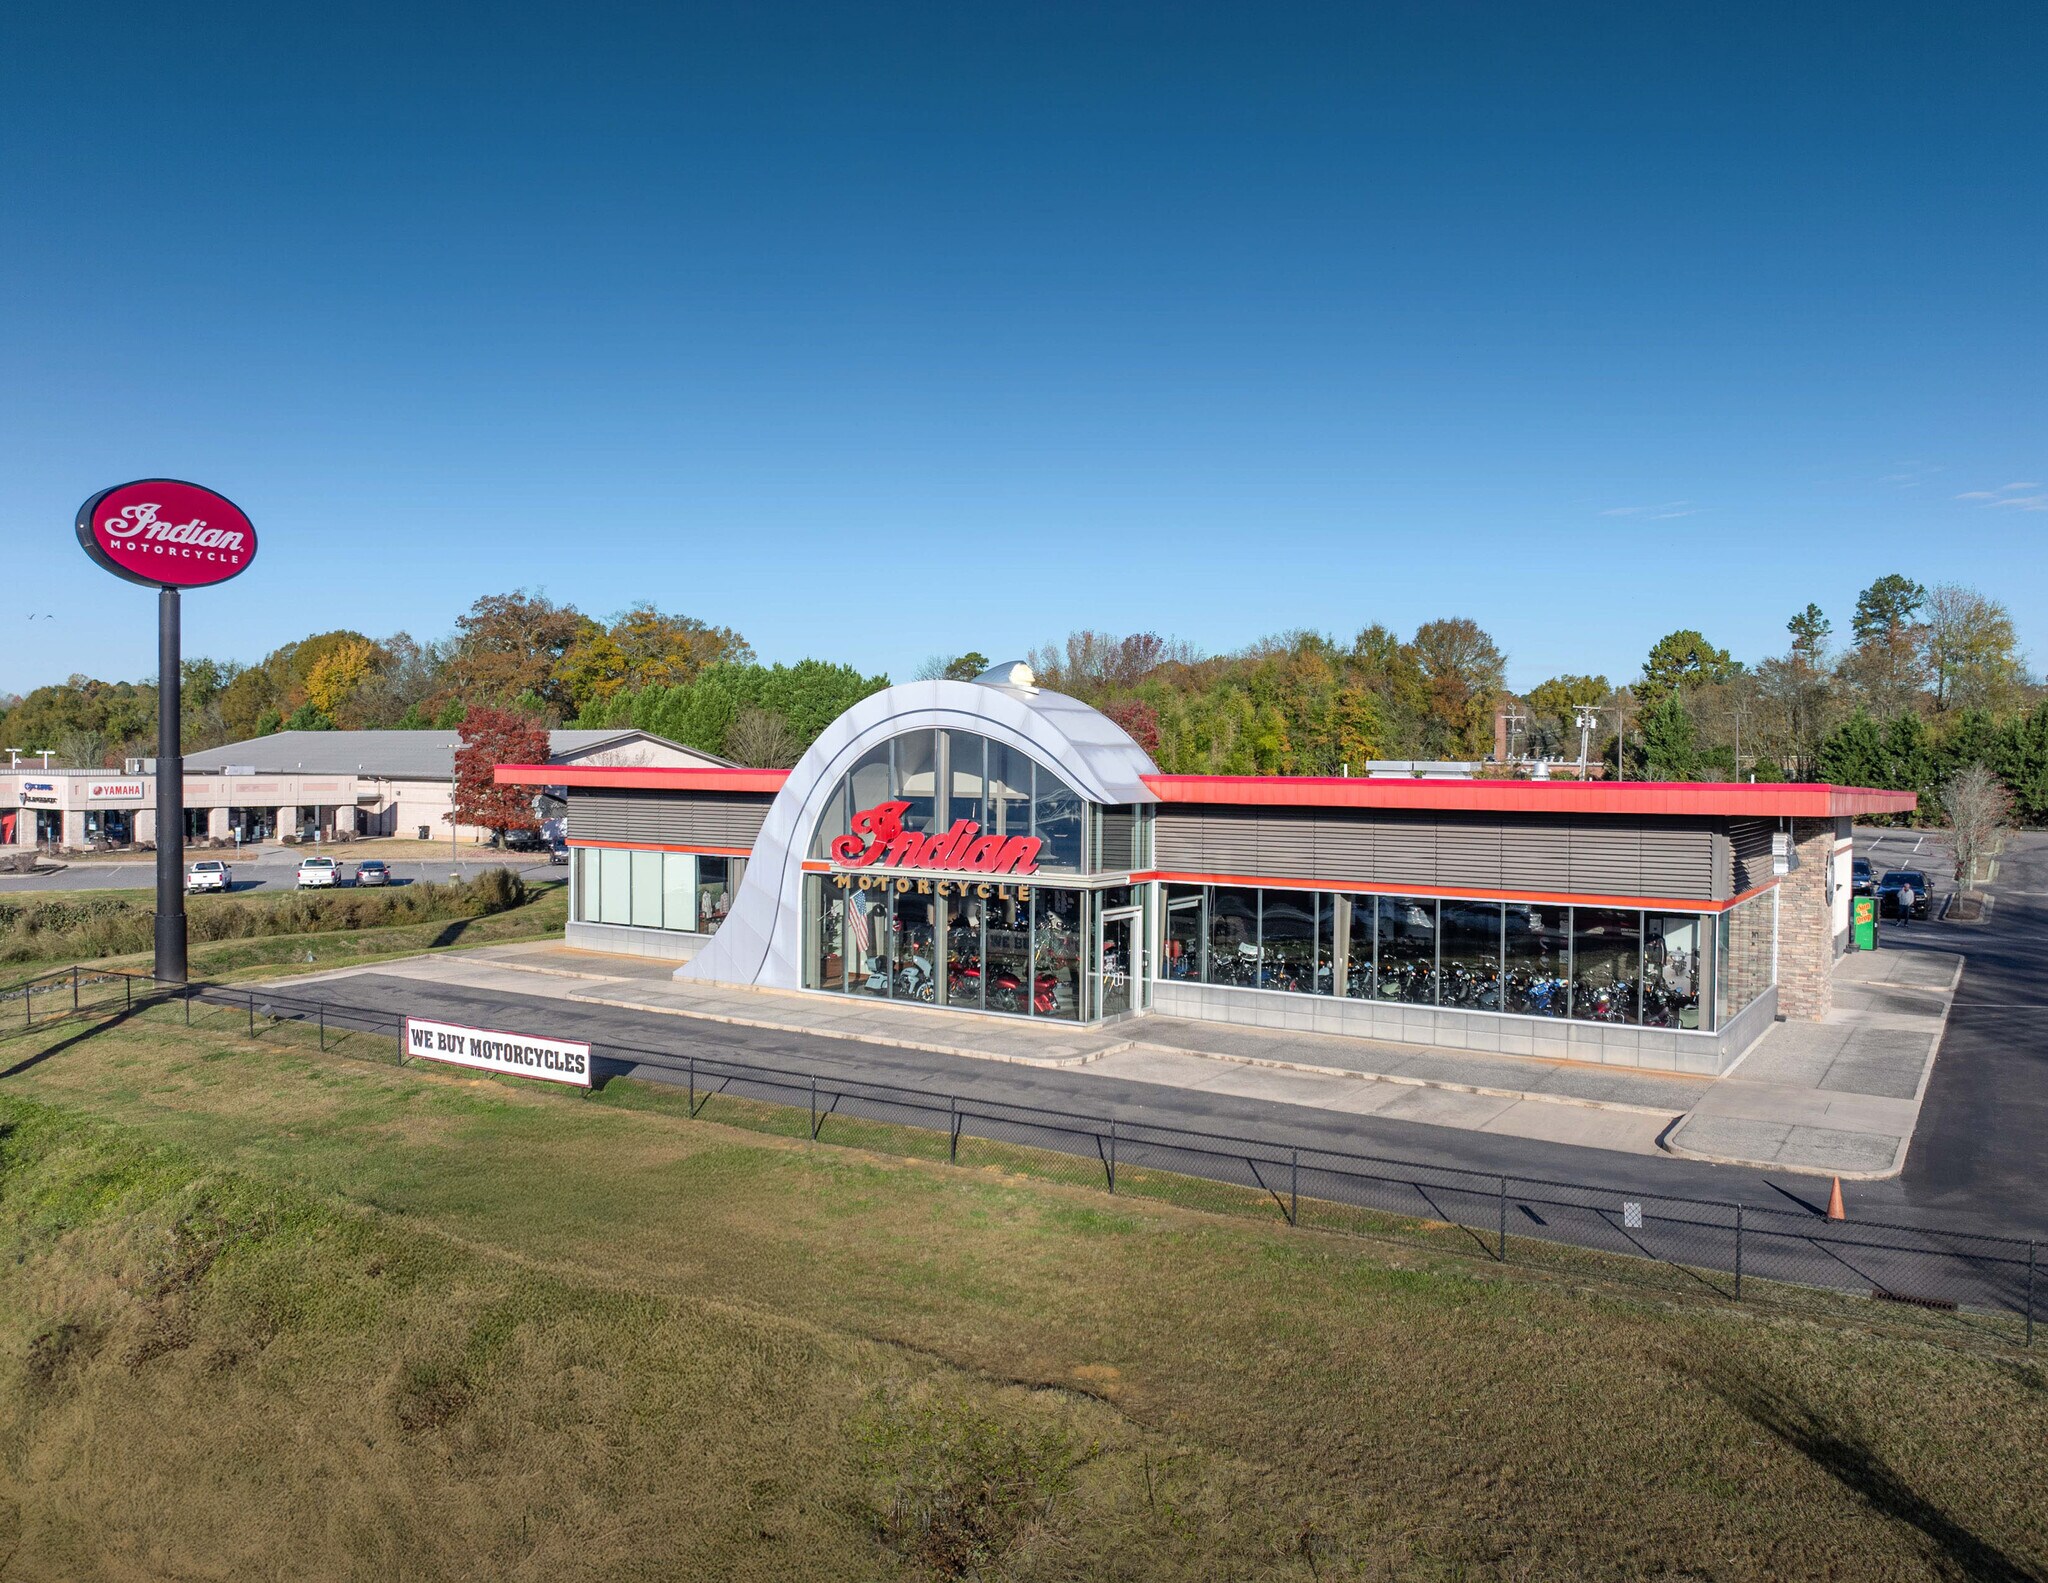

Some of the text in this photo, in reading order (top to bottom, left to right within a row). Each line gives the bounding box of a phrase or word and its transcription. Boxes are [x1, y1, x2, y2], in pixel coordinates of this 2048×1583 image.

[104, 503, 244, 551] Indian
[110, 539, 239, 564] MOTORCYCLE
[104, 784, 140, 796] YAMAHA
[830, 801, 1042, 876] Indian
[835, 874, 1031, 902] MOTORCYCLE
[411, 1028, 586, 1075] WE BUY MOTORCYCLES
